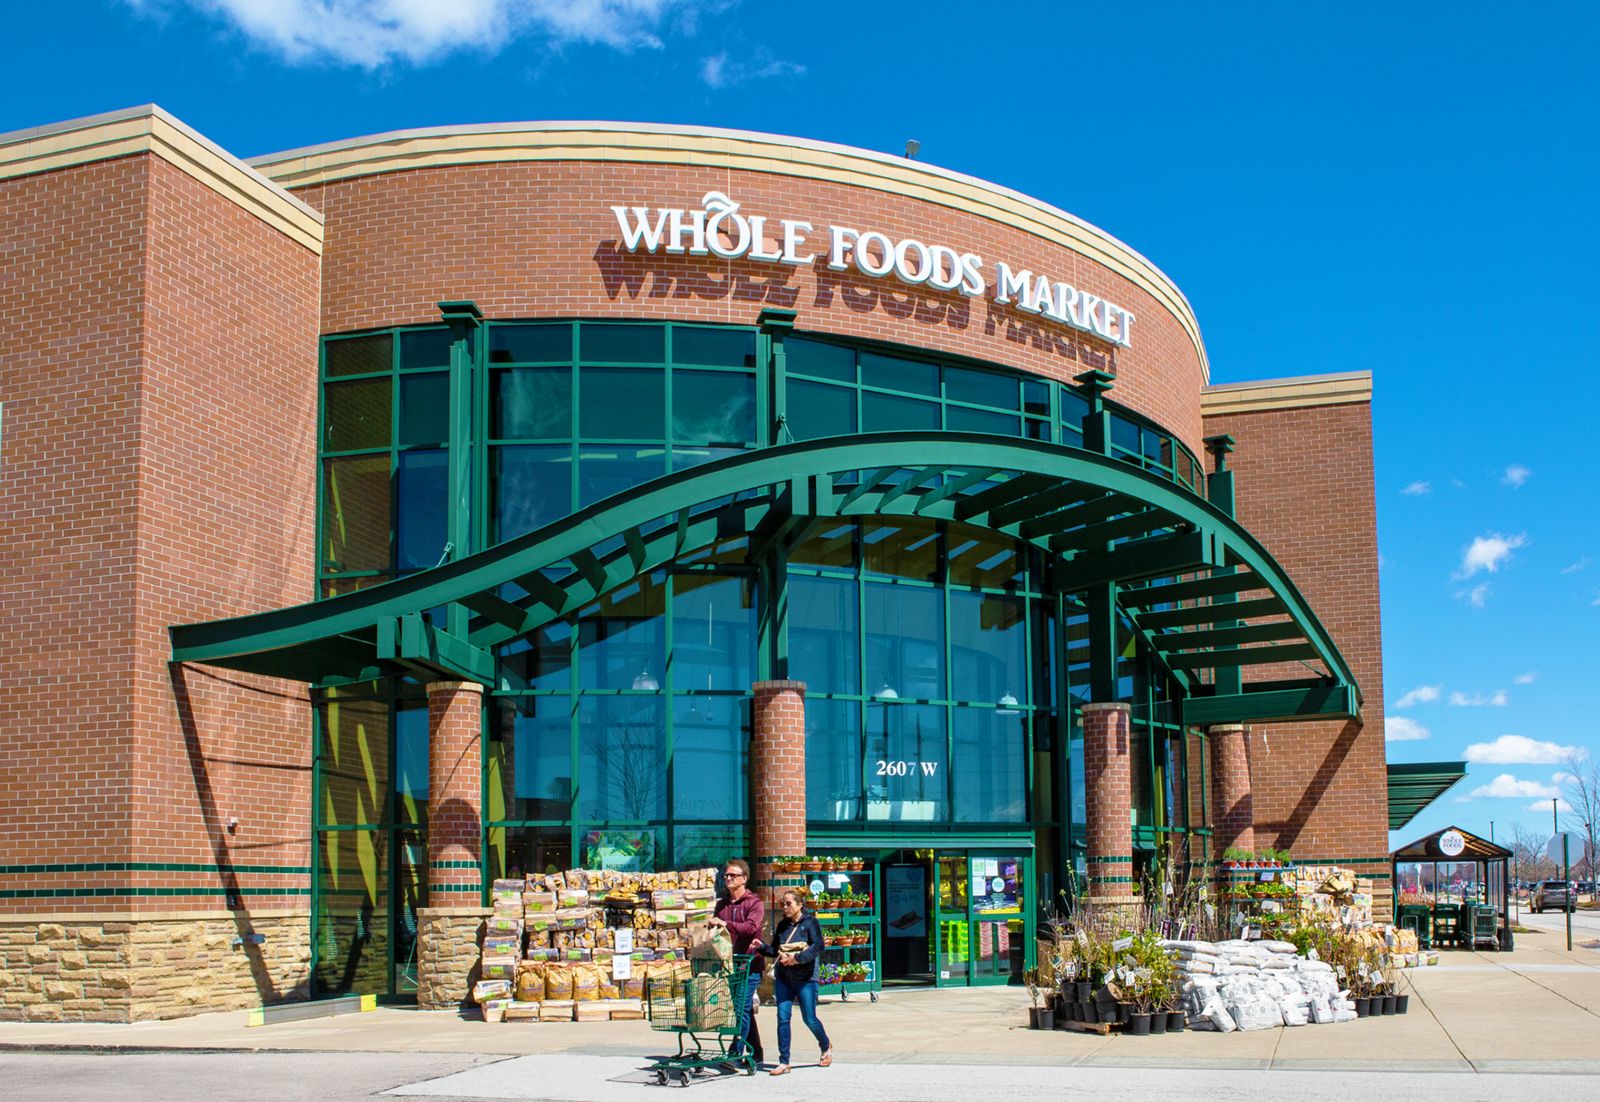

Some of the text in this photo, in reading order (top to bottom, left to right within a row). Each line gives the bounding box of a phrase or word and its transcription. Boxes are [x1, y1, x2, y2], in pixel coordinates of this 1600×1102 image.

[610, 191, 1136, 349] WHOLE FOODS MARKET
[876, 760, 938, 777] 2607 W
